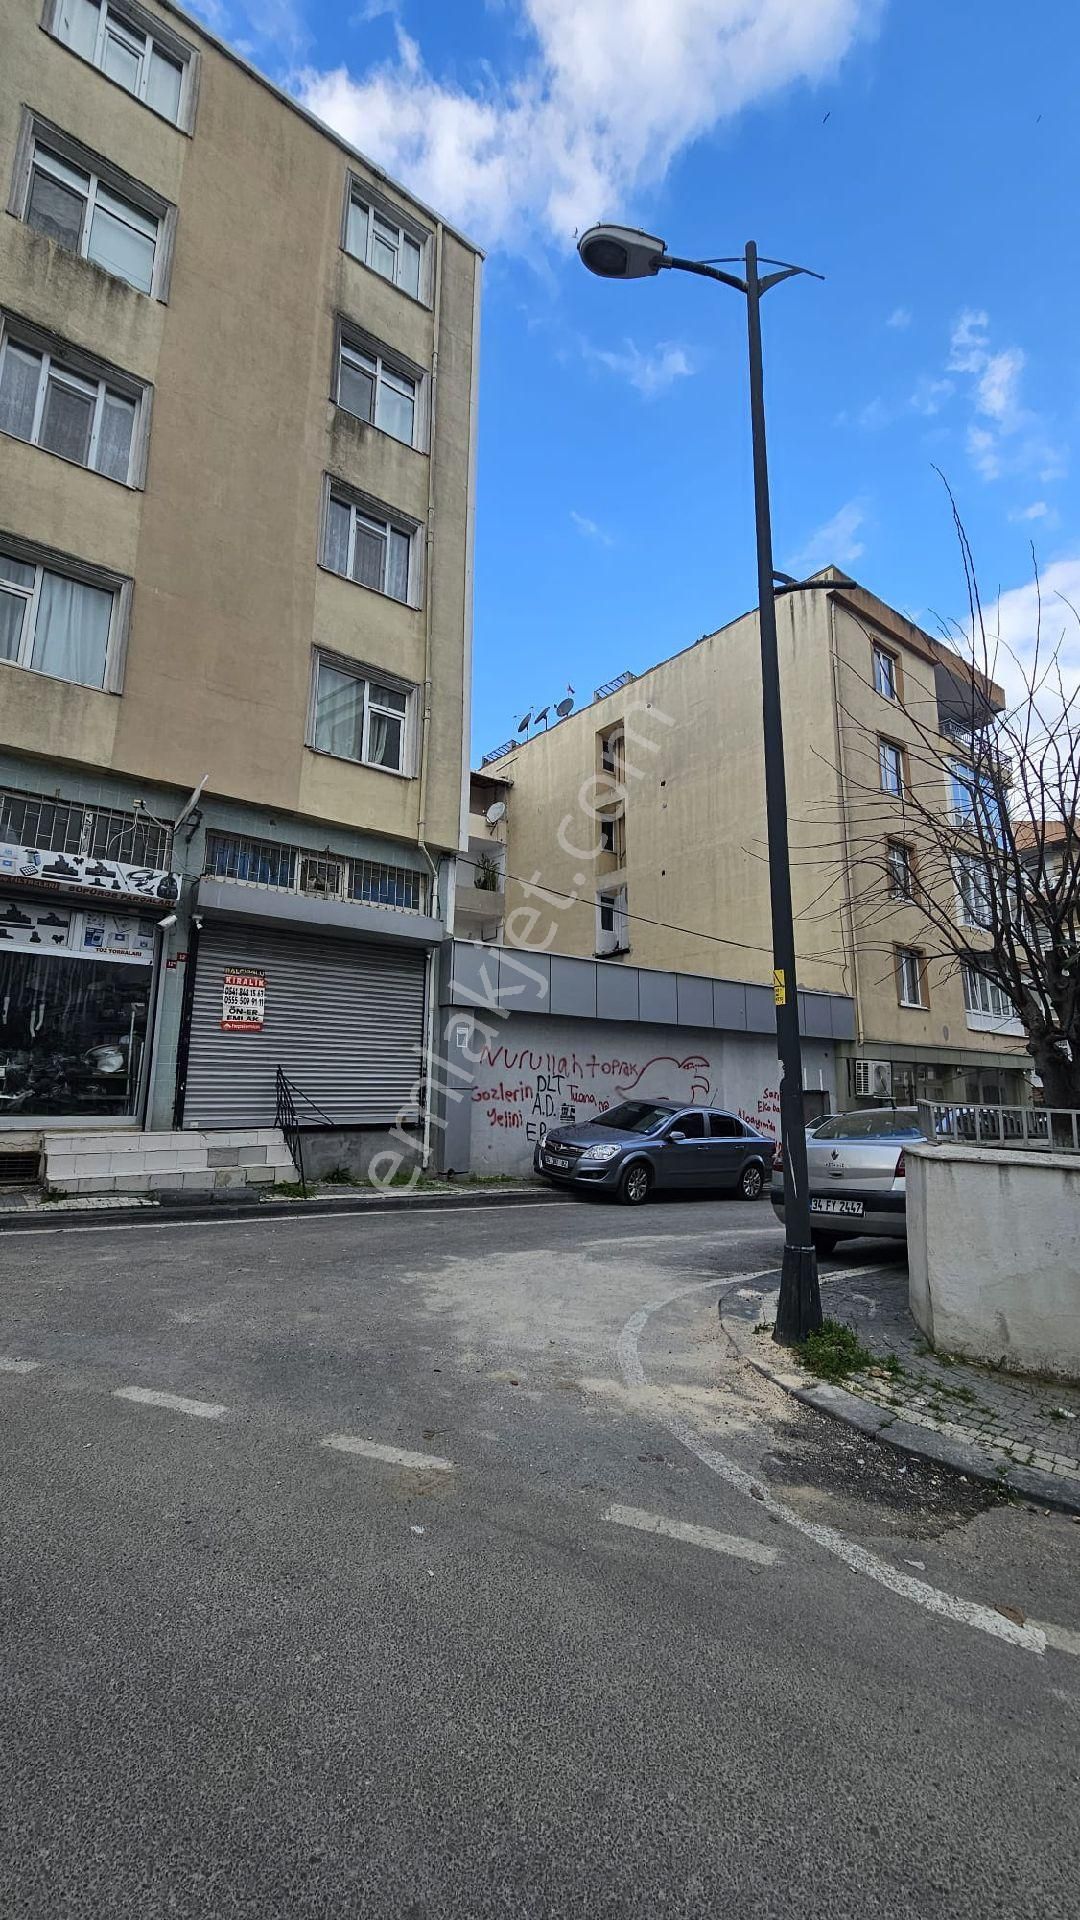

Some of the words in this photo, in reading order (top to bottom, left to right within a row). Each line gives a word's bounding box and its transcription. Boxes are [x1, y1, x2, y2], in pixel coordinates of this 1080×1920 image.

[536, 1074, 566, 1095] DLT
[811, 1199, 823, 1211] 34
[825, 1200, 837, 1212] FY
[839, 1201, 863, 1214] 2447
